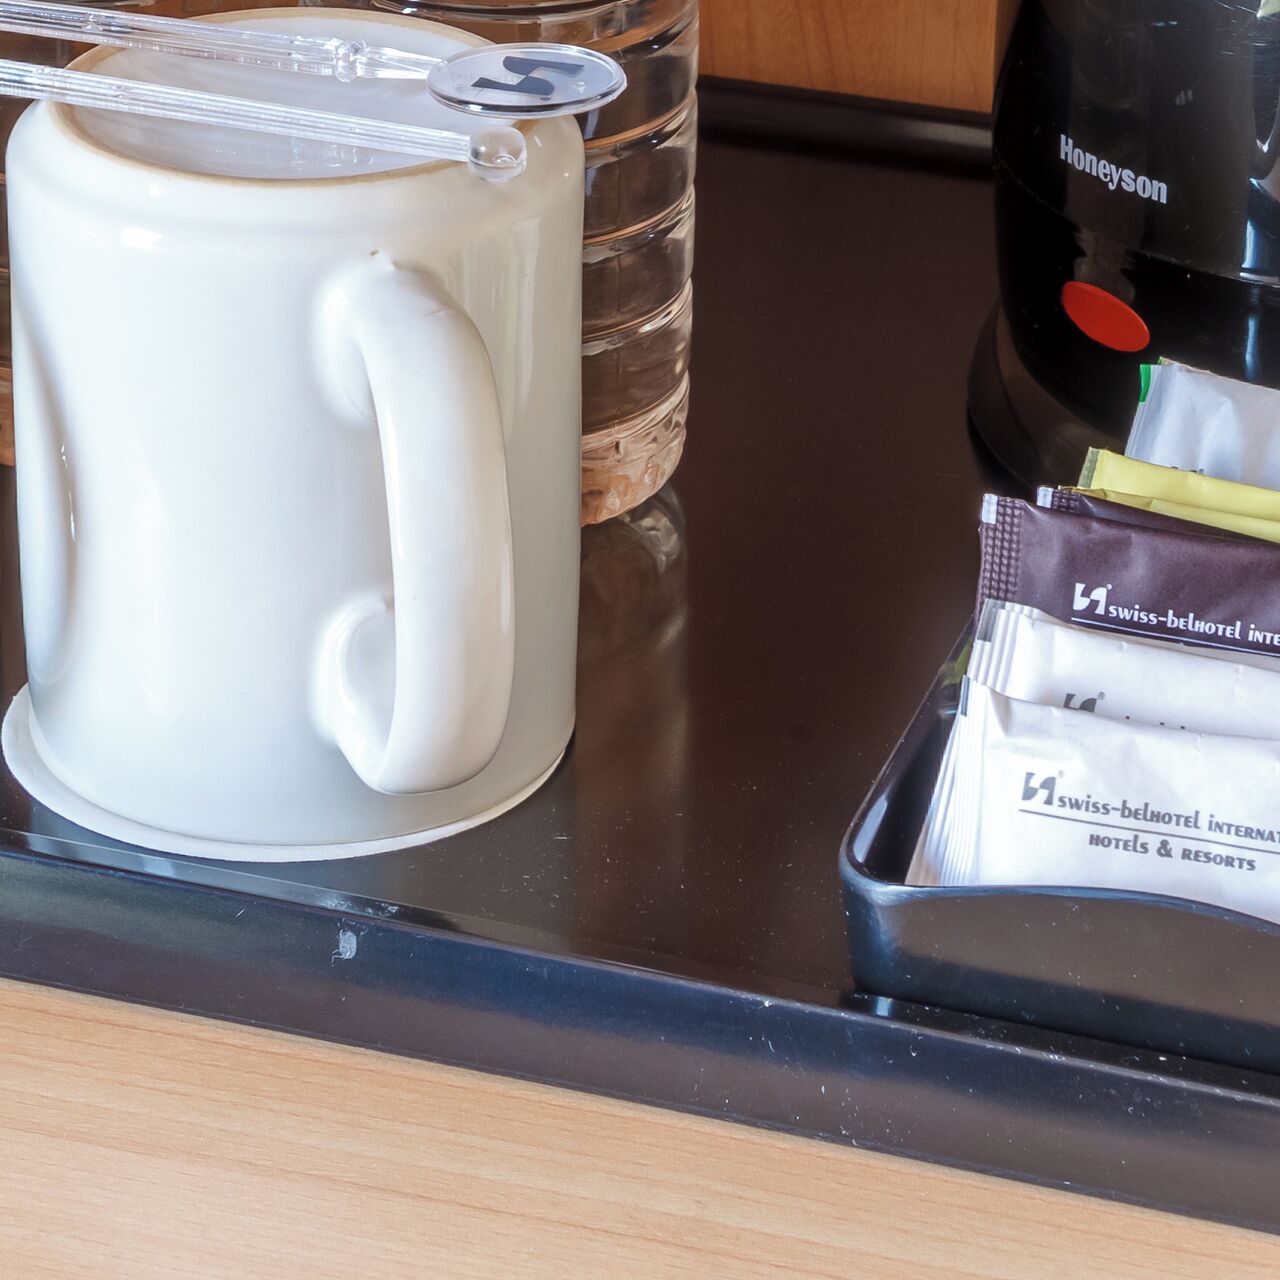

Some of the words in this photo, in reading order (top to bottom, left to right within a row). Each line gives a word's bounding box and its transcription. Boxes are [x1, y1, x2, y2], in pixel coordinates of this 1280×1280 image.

[1060, 133, 1167, 204] Honeyson
[1156, 839, 1173, 859] &
[1180, 847, 1256, 871] RESORTS
